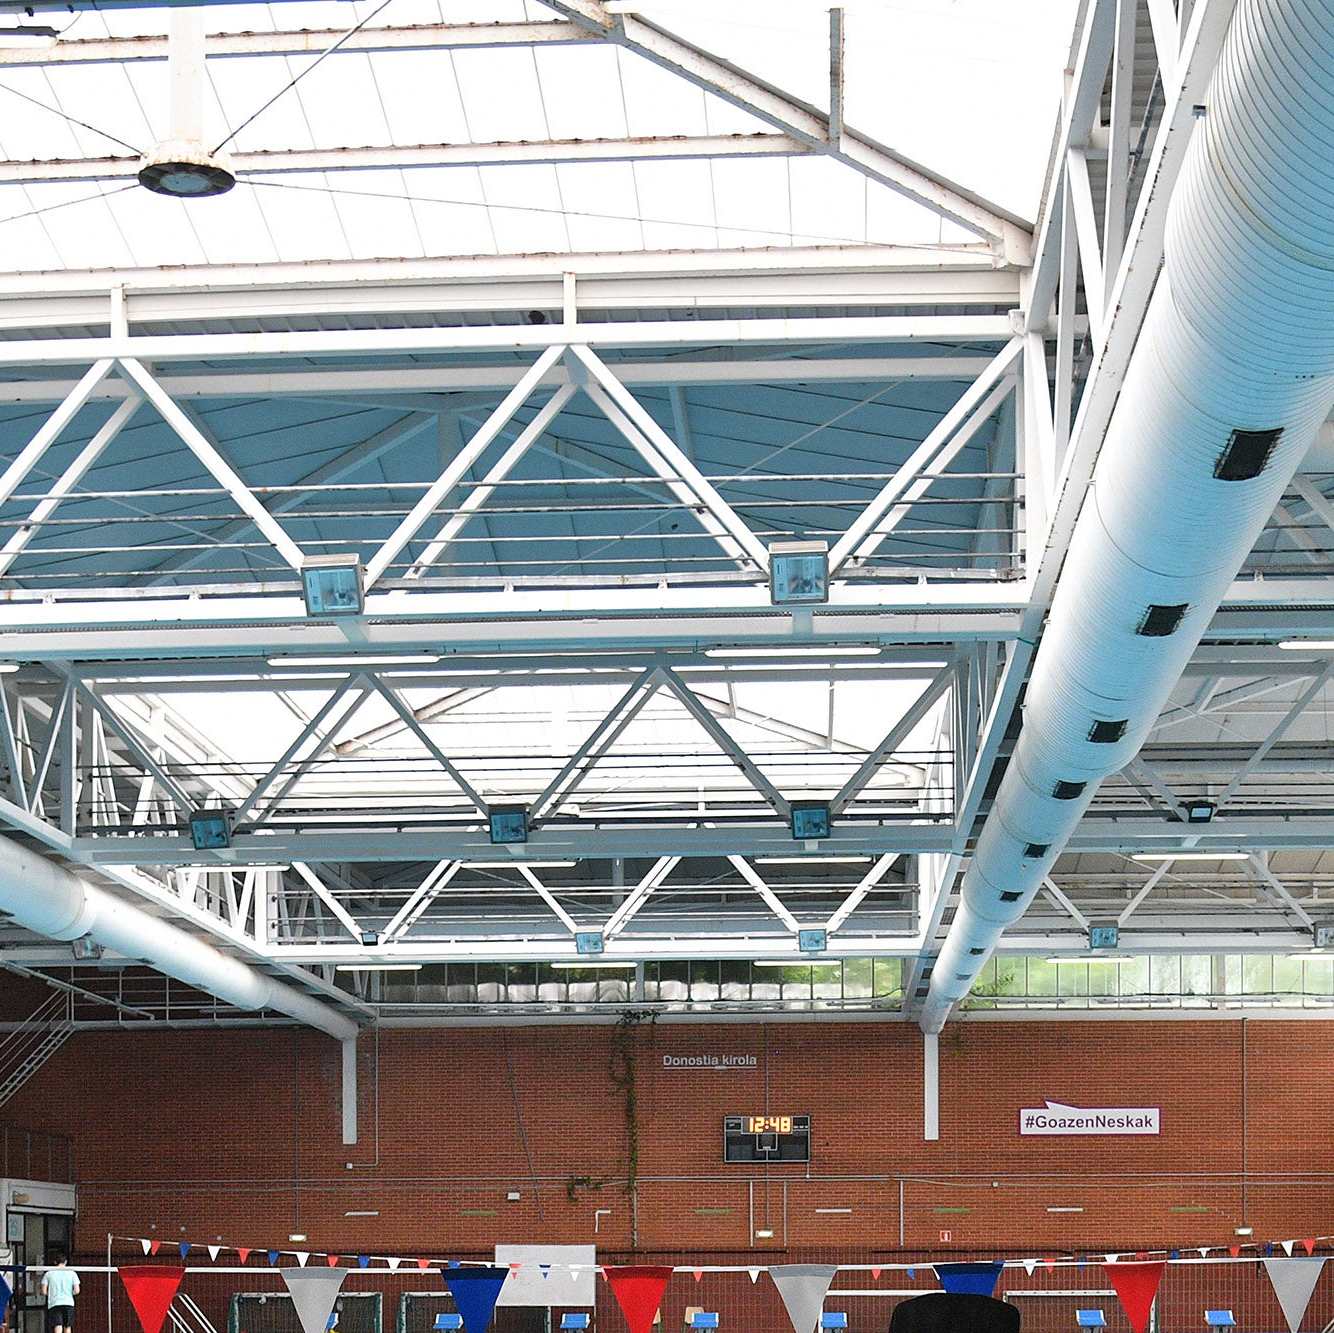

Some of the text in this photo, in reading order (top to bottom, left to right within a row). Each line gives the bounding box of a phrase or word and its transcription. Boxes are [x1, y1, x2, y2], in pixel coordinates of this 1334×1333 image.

[663, 1054, 757, 1066] Donostia kirola
[749, 1117, 791, 1133] 12:48
[1025, 1115, 1153, 1129] #GoazenNeskak
